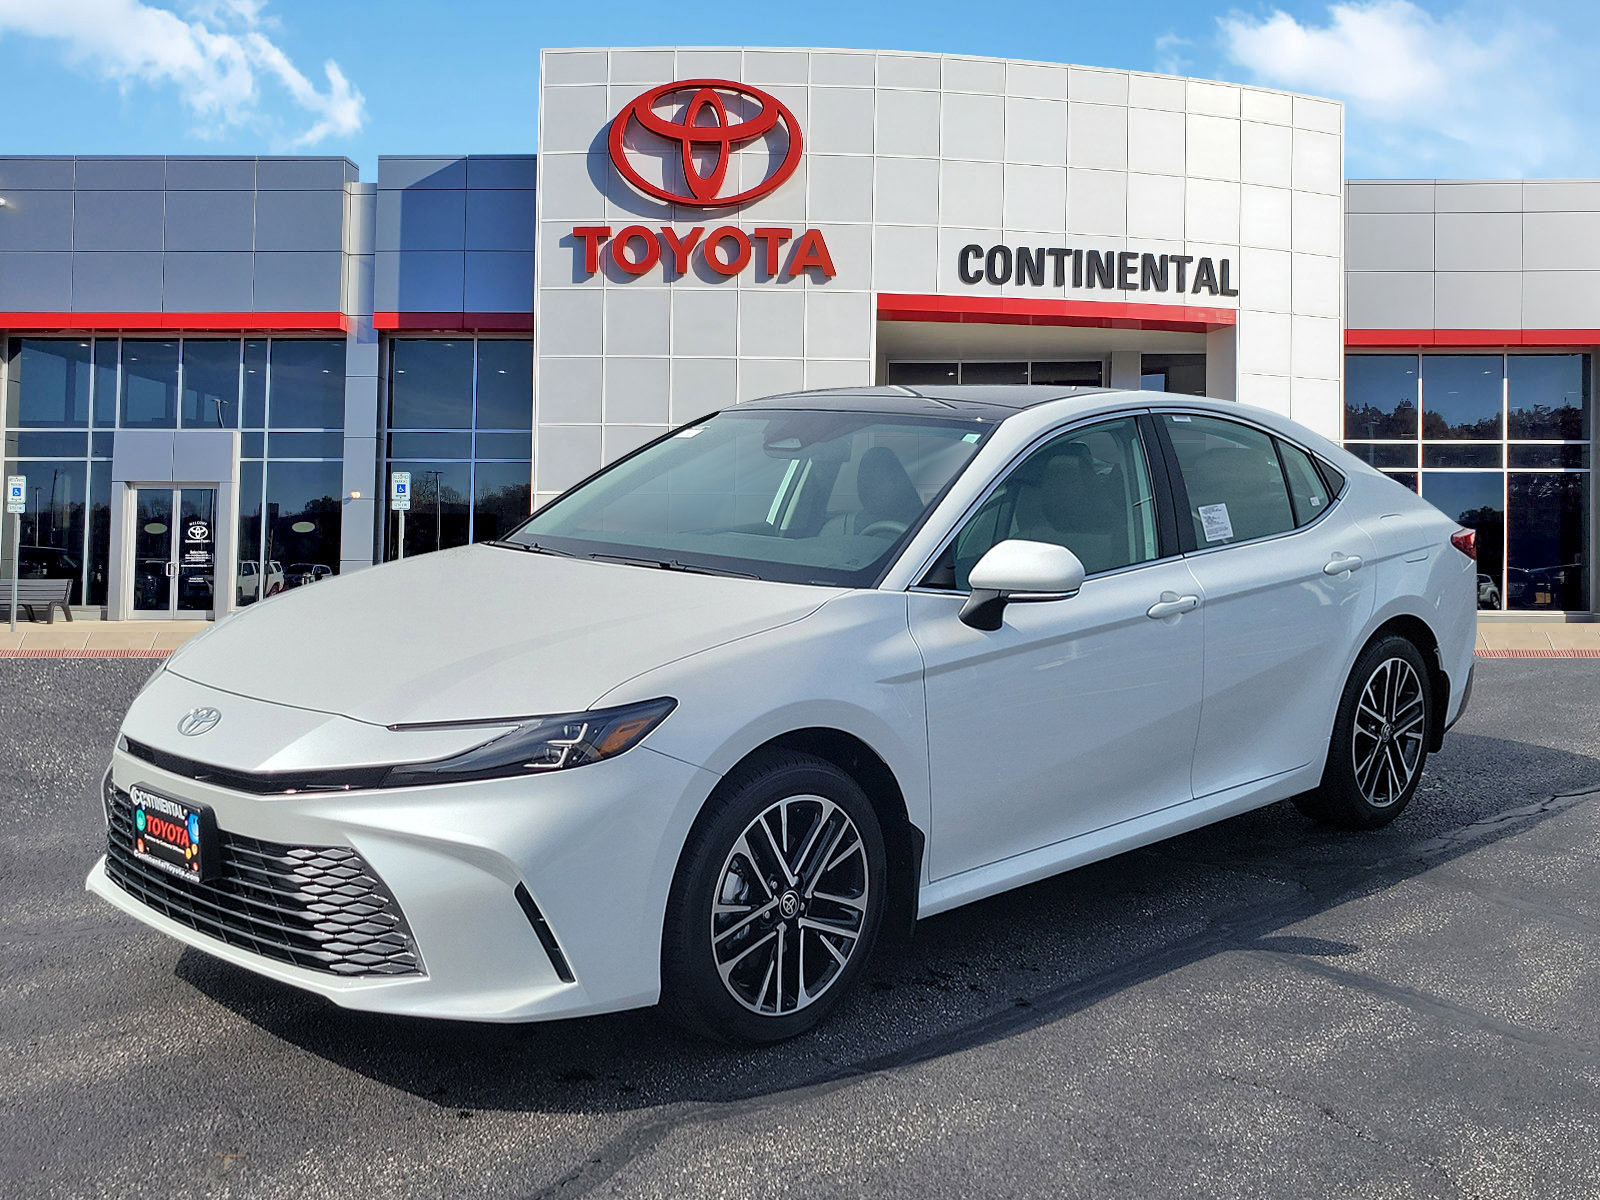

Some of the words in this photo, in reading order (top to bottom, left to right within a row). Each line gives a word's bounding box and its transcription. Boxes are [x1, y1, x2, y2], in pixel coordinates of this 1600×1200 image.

[572, 225, 837, 277] TOYOTA
[959, 244, 1239, 297] CONTINENTAL
[145, 814, 190, 848] TOYOTA
